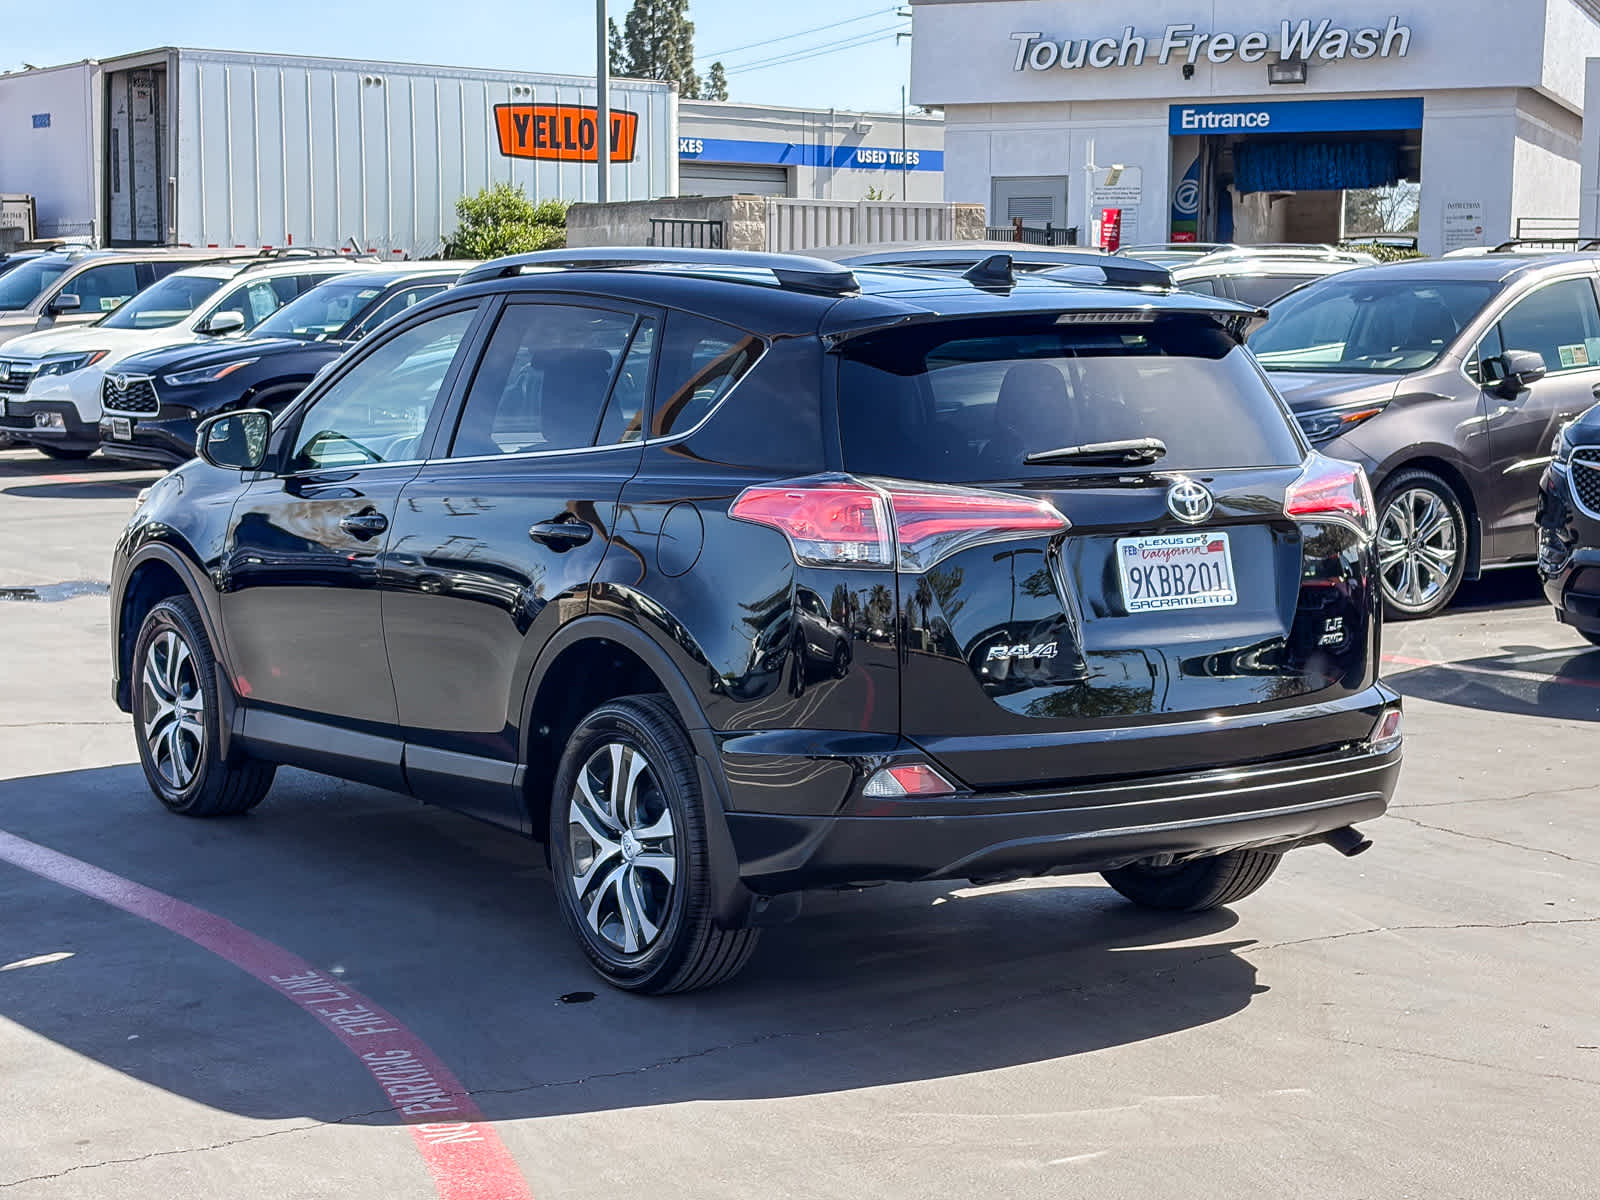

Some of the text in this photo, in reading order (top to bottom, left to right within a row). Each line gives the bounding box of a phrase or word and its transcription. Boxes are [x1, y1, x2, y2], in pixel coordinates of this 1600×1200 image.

[1010, 16, 1411, 72] Touch Free Wash
[1181, 109, 1270, 129] Entrance
[679, 138, 704, 153] KES
[857, 149, 887, 164] USED
[1145, 536, 1183, 547] LEXUS
[1124, 545, 1138, 556] FEB
[1129, 562, 1222, 600] 9KBB201
[1130, 595, 1233, 610] SACRAMENTO
[986, 641, 1058, 661] RAV4
[270, 970, 484, 1145] NO PARKING FIRE LANE
